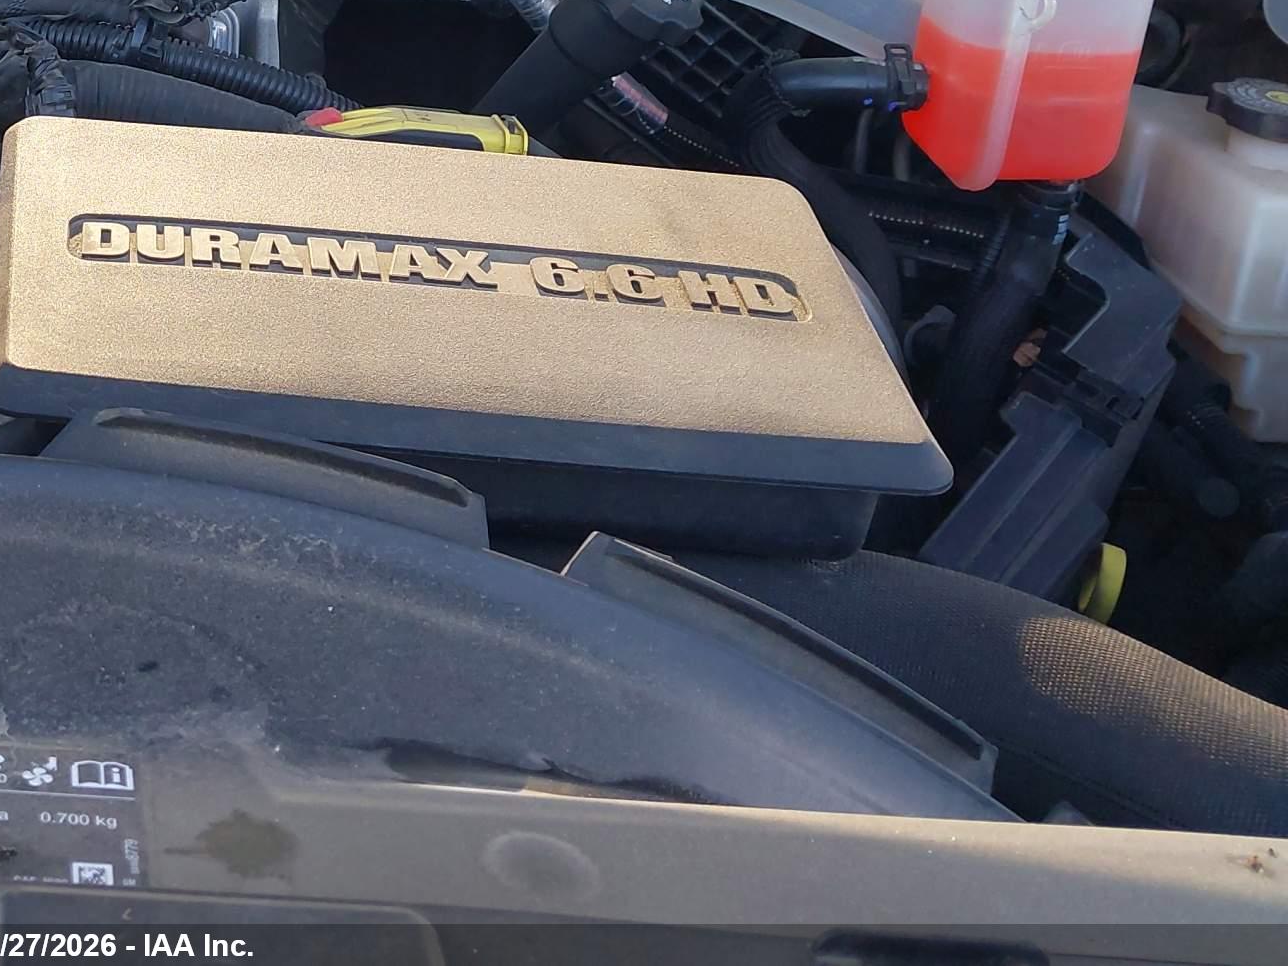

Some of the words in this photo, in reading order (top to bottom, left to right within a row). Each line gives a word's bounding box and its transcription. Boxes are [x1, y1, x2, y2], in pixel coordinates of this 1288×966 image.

[80, 220, 499, 290] DURAMAX
[529, 256, 667, 304] 6.6
[677, 270, 798, 320] HD
[39, 811, 91, 827] 0.700
[95, 814, 118, 830] kg
